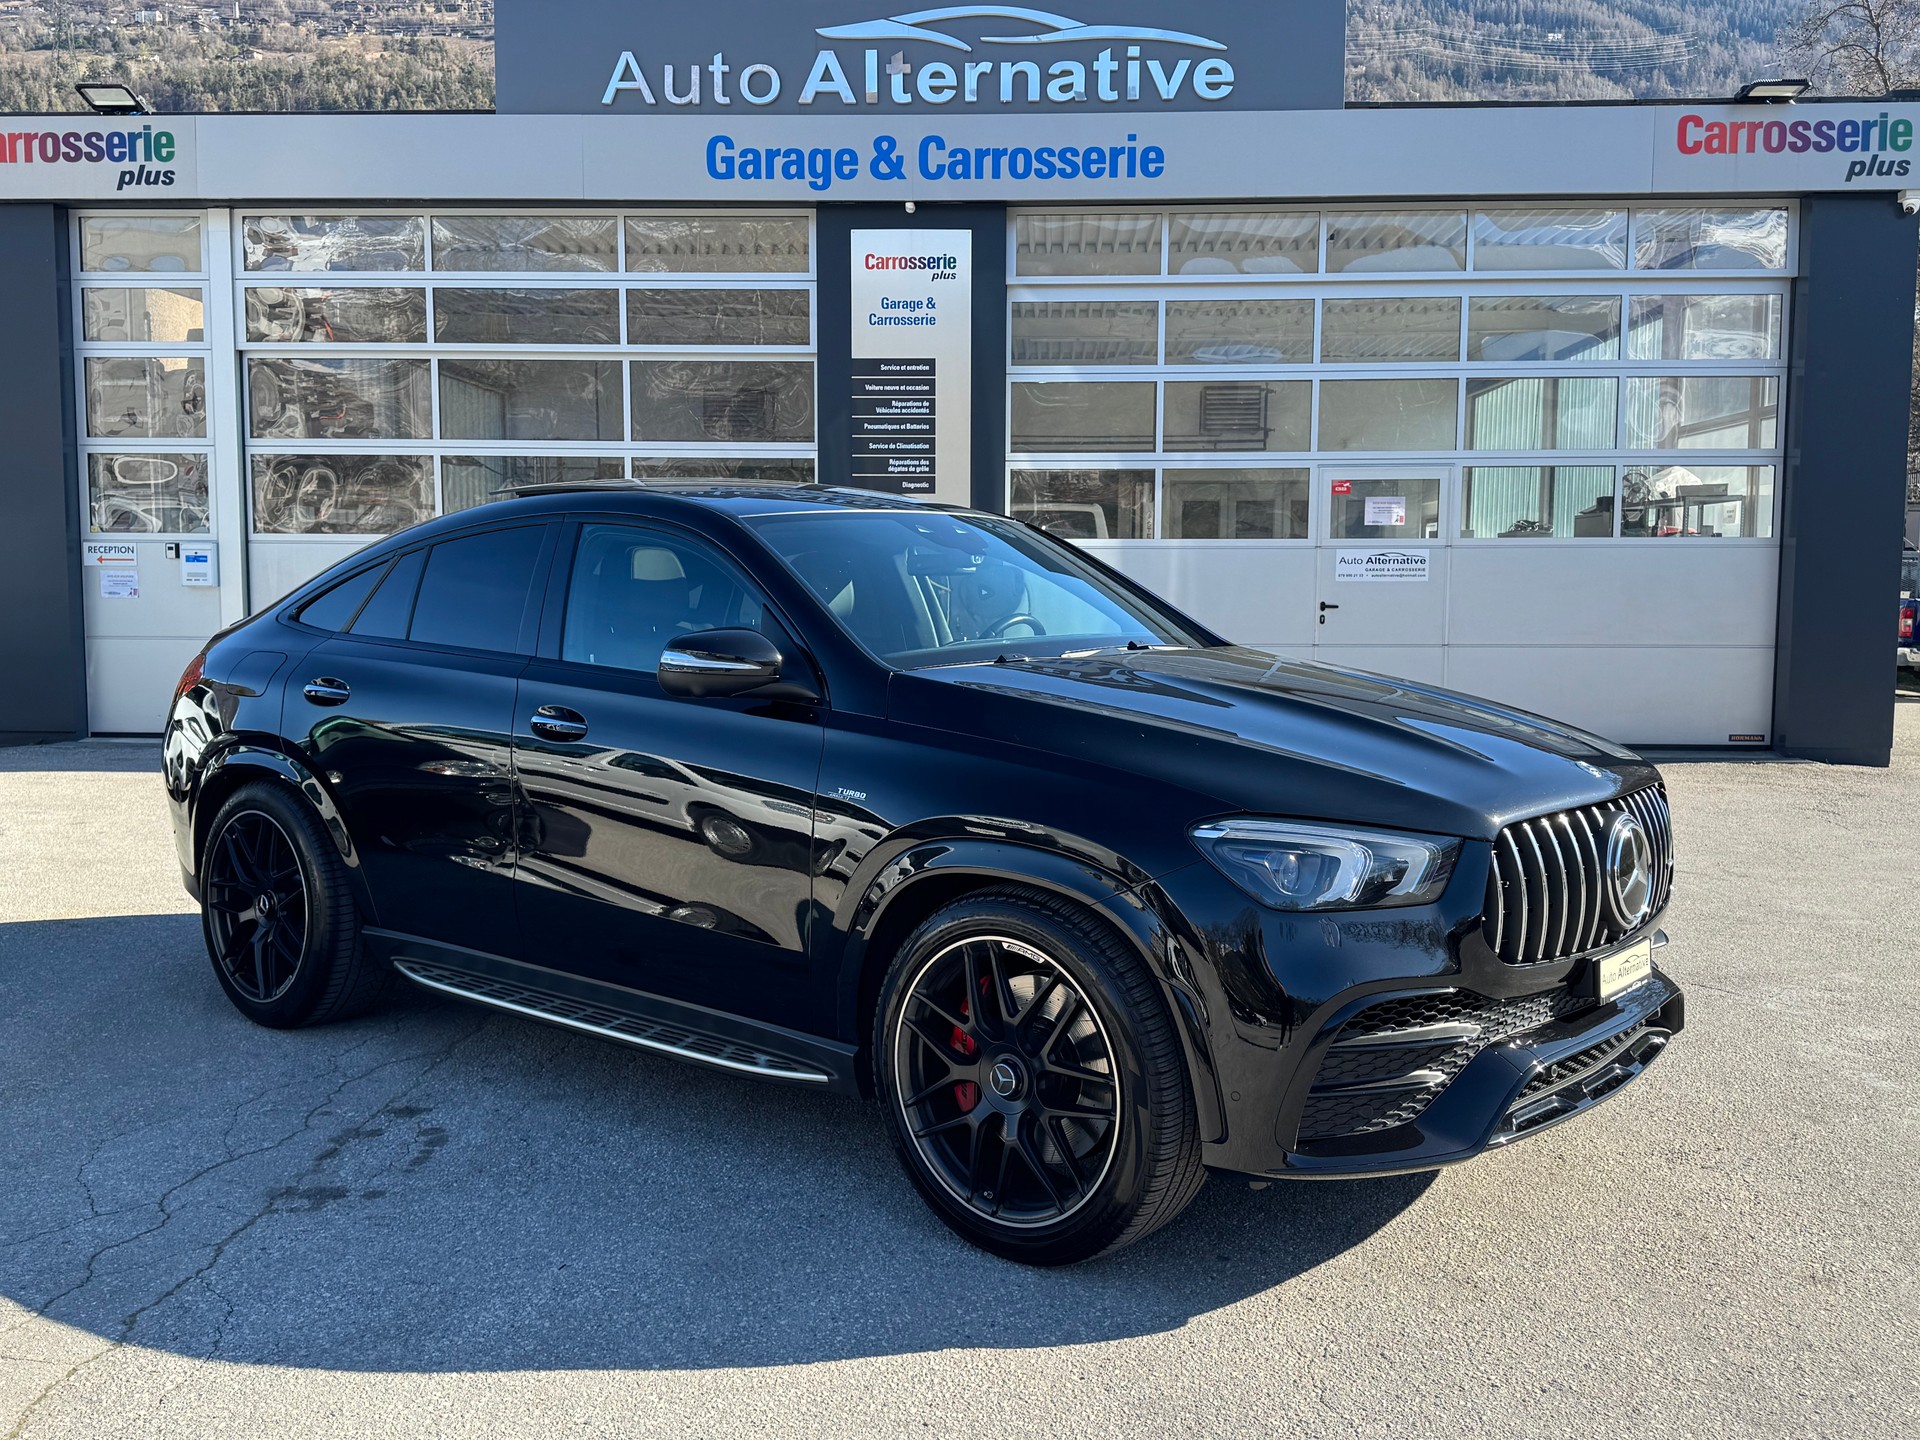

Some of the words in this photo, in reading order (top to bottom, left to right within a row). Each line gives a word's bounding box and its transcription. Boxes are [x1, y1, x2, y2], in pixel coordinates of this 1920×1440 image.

[601, 50, 782, 106] Auto
[799, 46, 1236, 105] Alternative
[1677, 112, 1914, 155] Carrosserie
[706, 135, 859, 190] Garage
[870, 135, 906, 181] &
[919, 134, 1165, 181] Carrosserie
[1845, 155, 1911, 182] plus
[116, 164, 176, 191] plus
[865, 253, 957, 270] Carrosserie
[931, 270, 957, 282] plus
[881, 297, 924, 312] Garage
[926, 297, 936, 309] &
[869, 313, 936, 325] Carrosserie
[891, 400, 922, 408] Réparations
[864, 423, 900, 431] Pneumatiques
[87, 546, 135, 554] RECEPTION
[1339, 556, 1364, 565] Auto
[1365, 556, 1427, 565] Alternative
[837, 787, 866, 799] TURBO
[1602, 972, 1617, 984] Auto
[1617, 957, 1649, 980] Alternative
